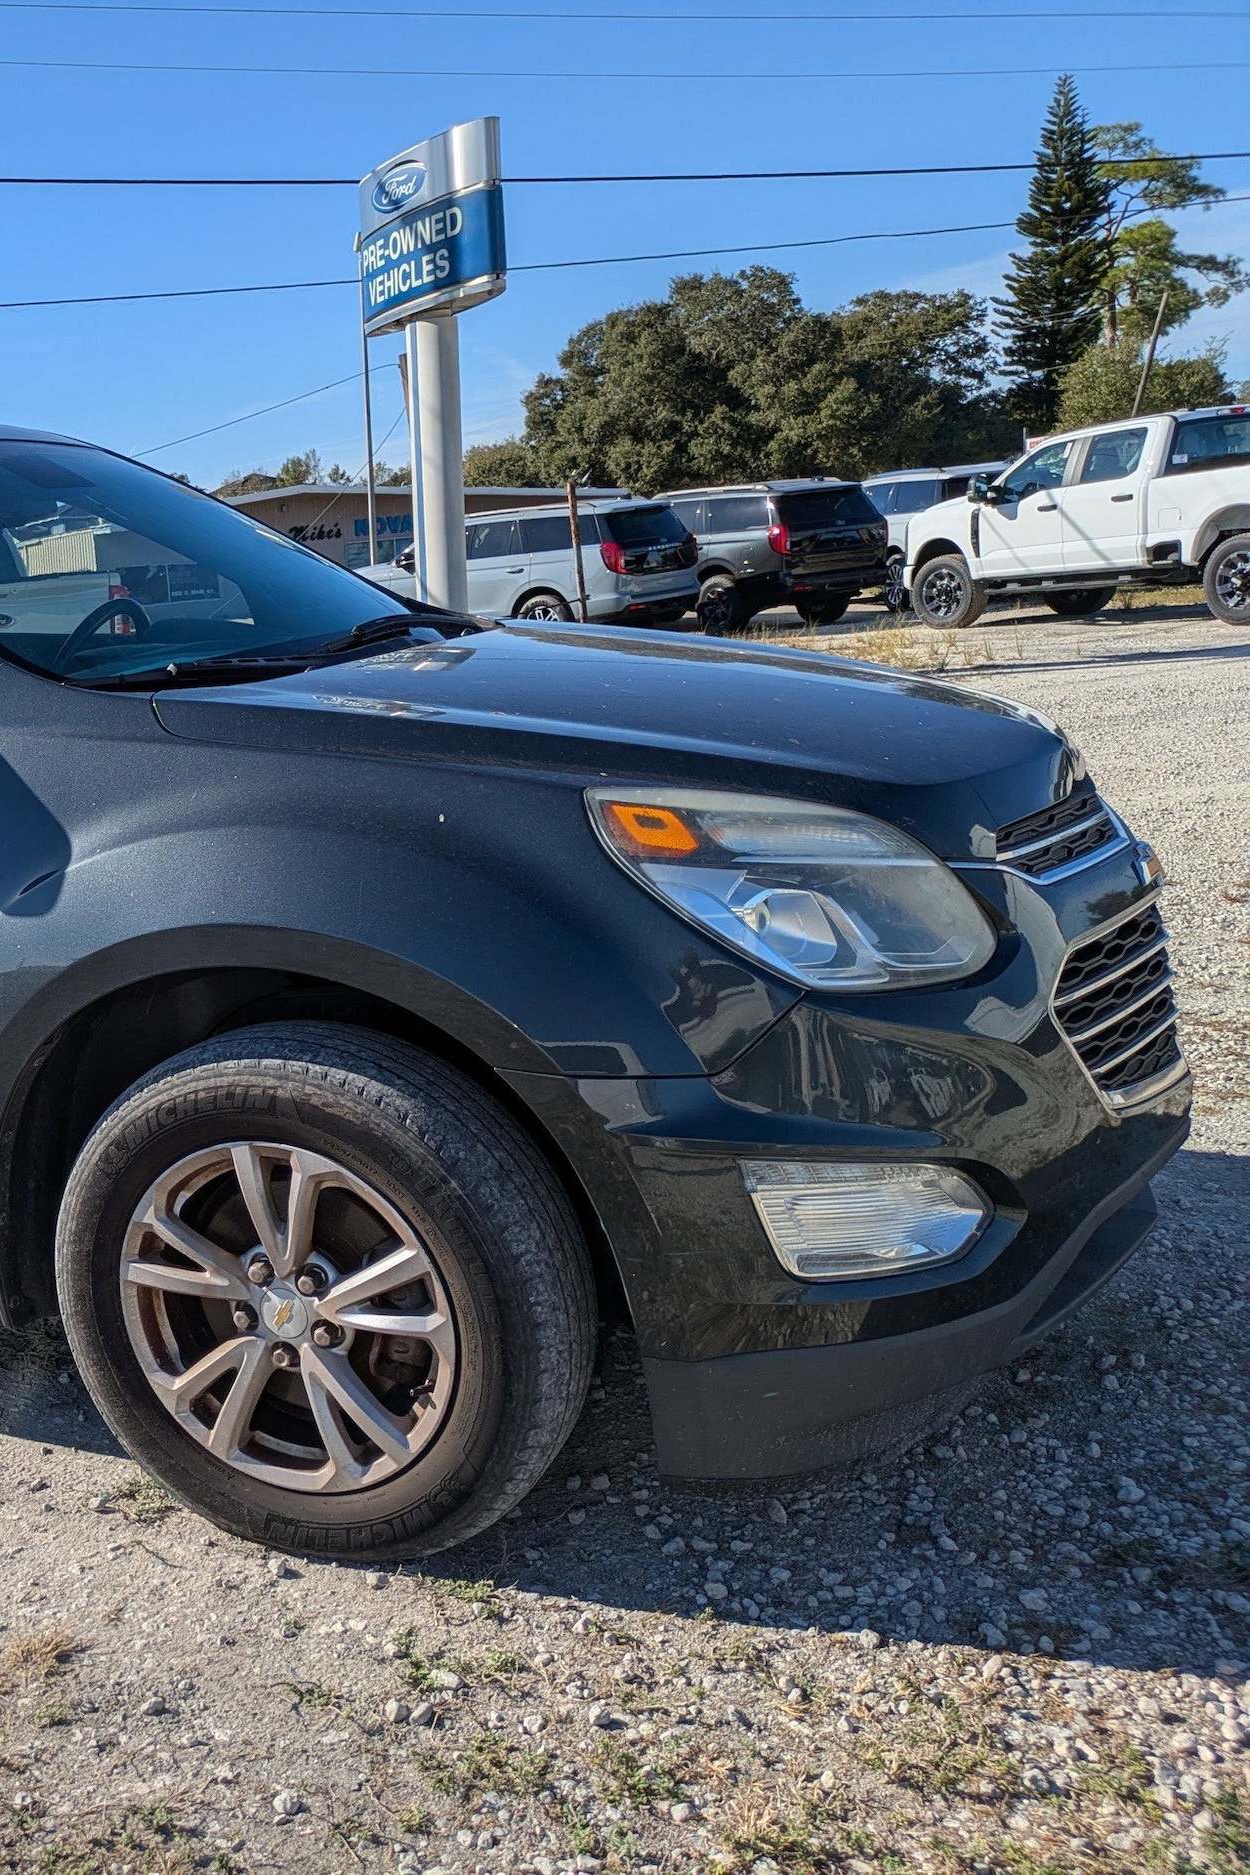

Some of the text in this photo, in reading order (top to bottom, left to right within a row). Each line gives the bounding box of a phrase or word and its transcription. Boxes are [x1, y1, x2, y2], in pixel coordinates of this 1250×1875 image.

[382, 174, 417, 204] Ford
[363, 207, 463, 277] PRE-OWNED
[368, 249, 450, 307] VEHICLES
[289, 523, 343, 542] Mike's
[124, 1086, 276, 1151] MICHELIN
[266, 1503, 436, 1550] MICHELIN
